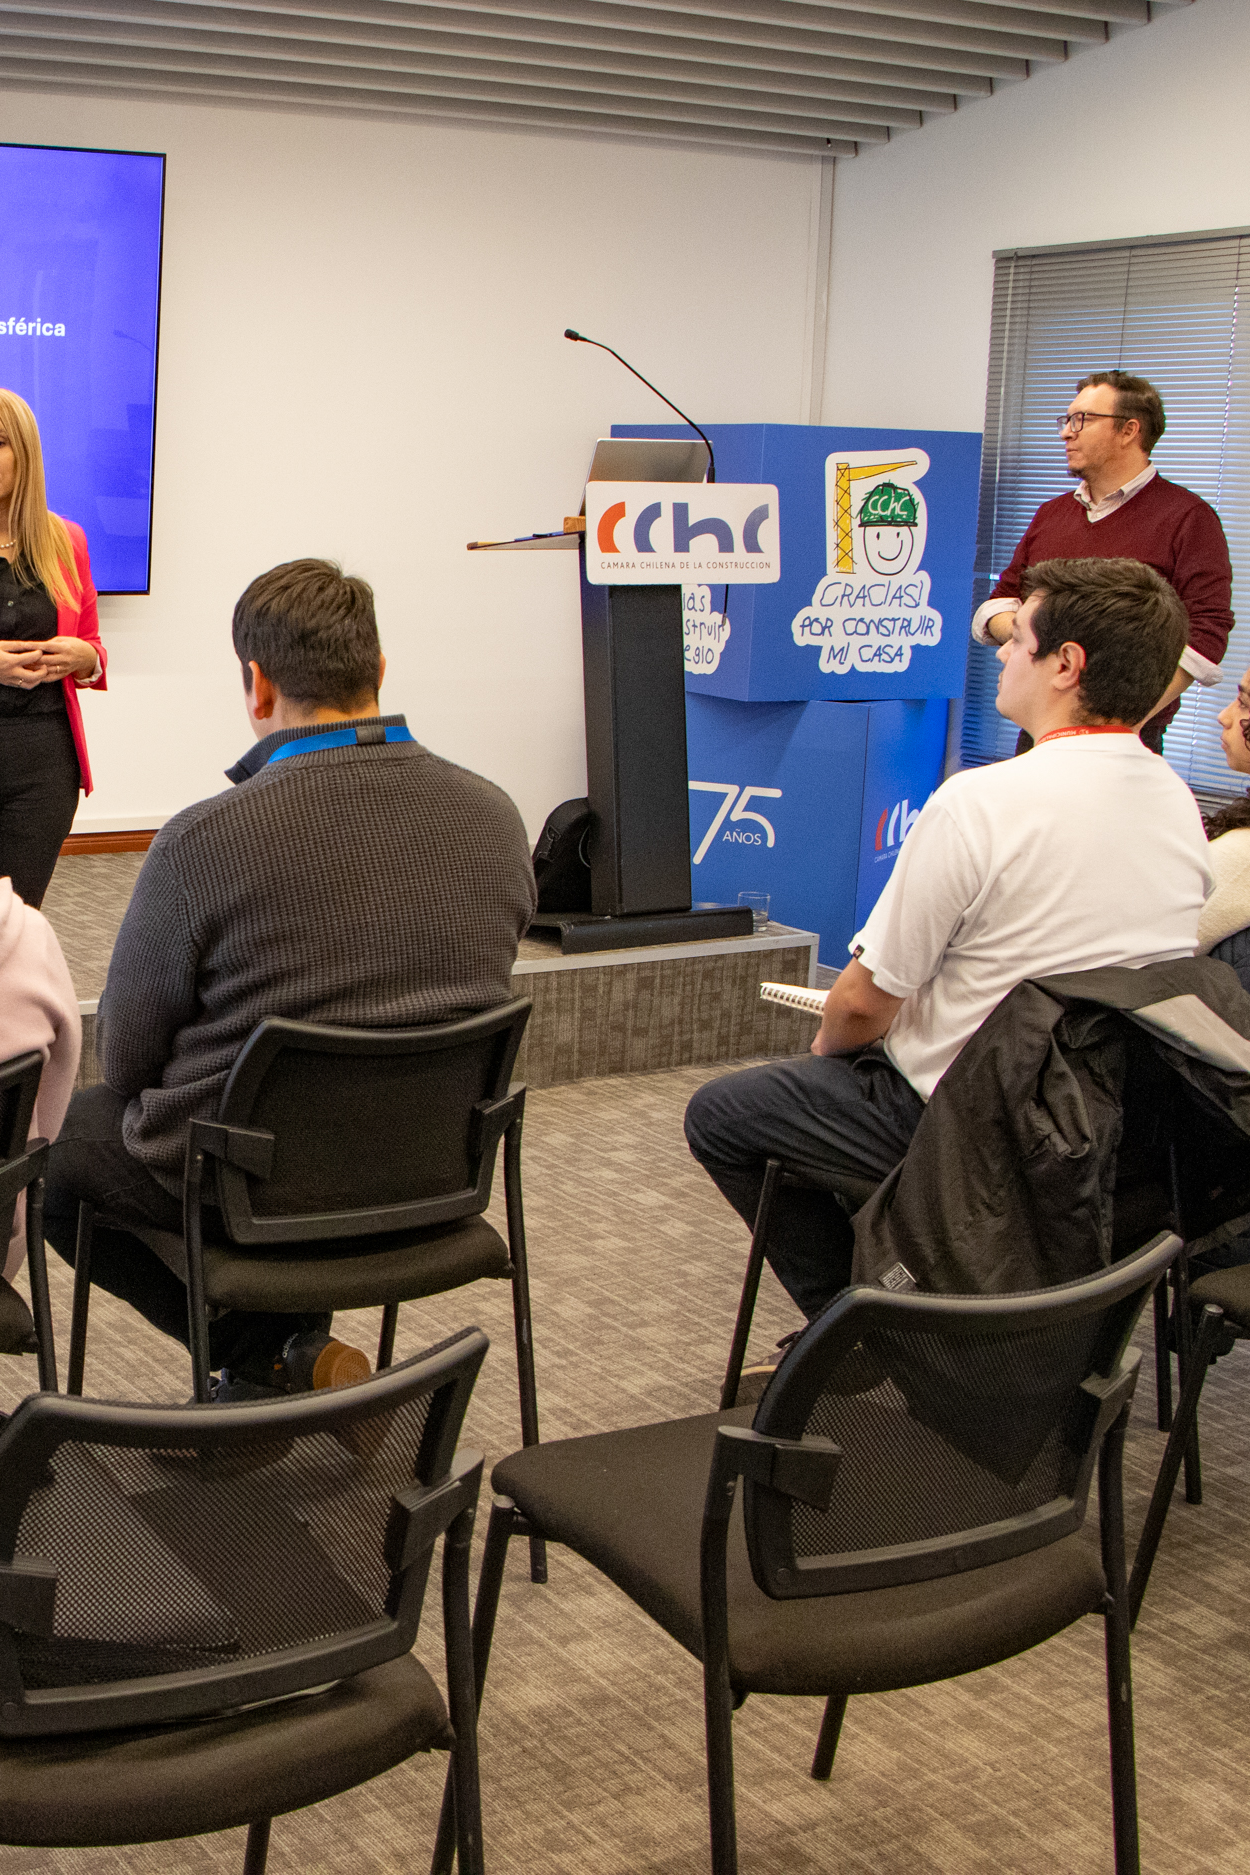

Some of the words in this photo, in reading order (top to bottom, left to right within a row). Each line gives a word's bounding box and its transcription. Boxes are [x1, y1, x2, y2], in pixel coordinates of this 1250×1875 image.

[600, 561, 636, 569] CAMARA
[640, 561, 676, 569] CHILENA
[680, 561, 689, 569] DE
[693, 561, 703, 569] LA
[706, 561, 771, 569] CONSTRUCCION
[800, 616, 833, 637] POR
[842, 615, 935, 637] CONSTRUIR
[827, 642, 850, 665] MI
[858, 644, 904, 663] CASA
[689, 781, 782, 864] 75
[722, 829, 762, 846] AÑOS
